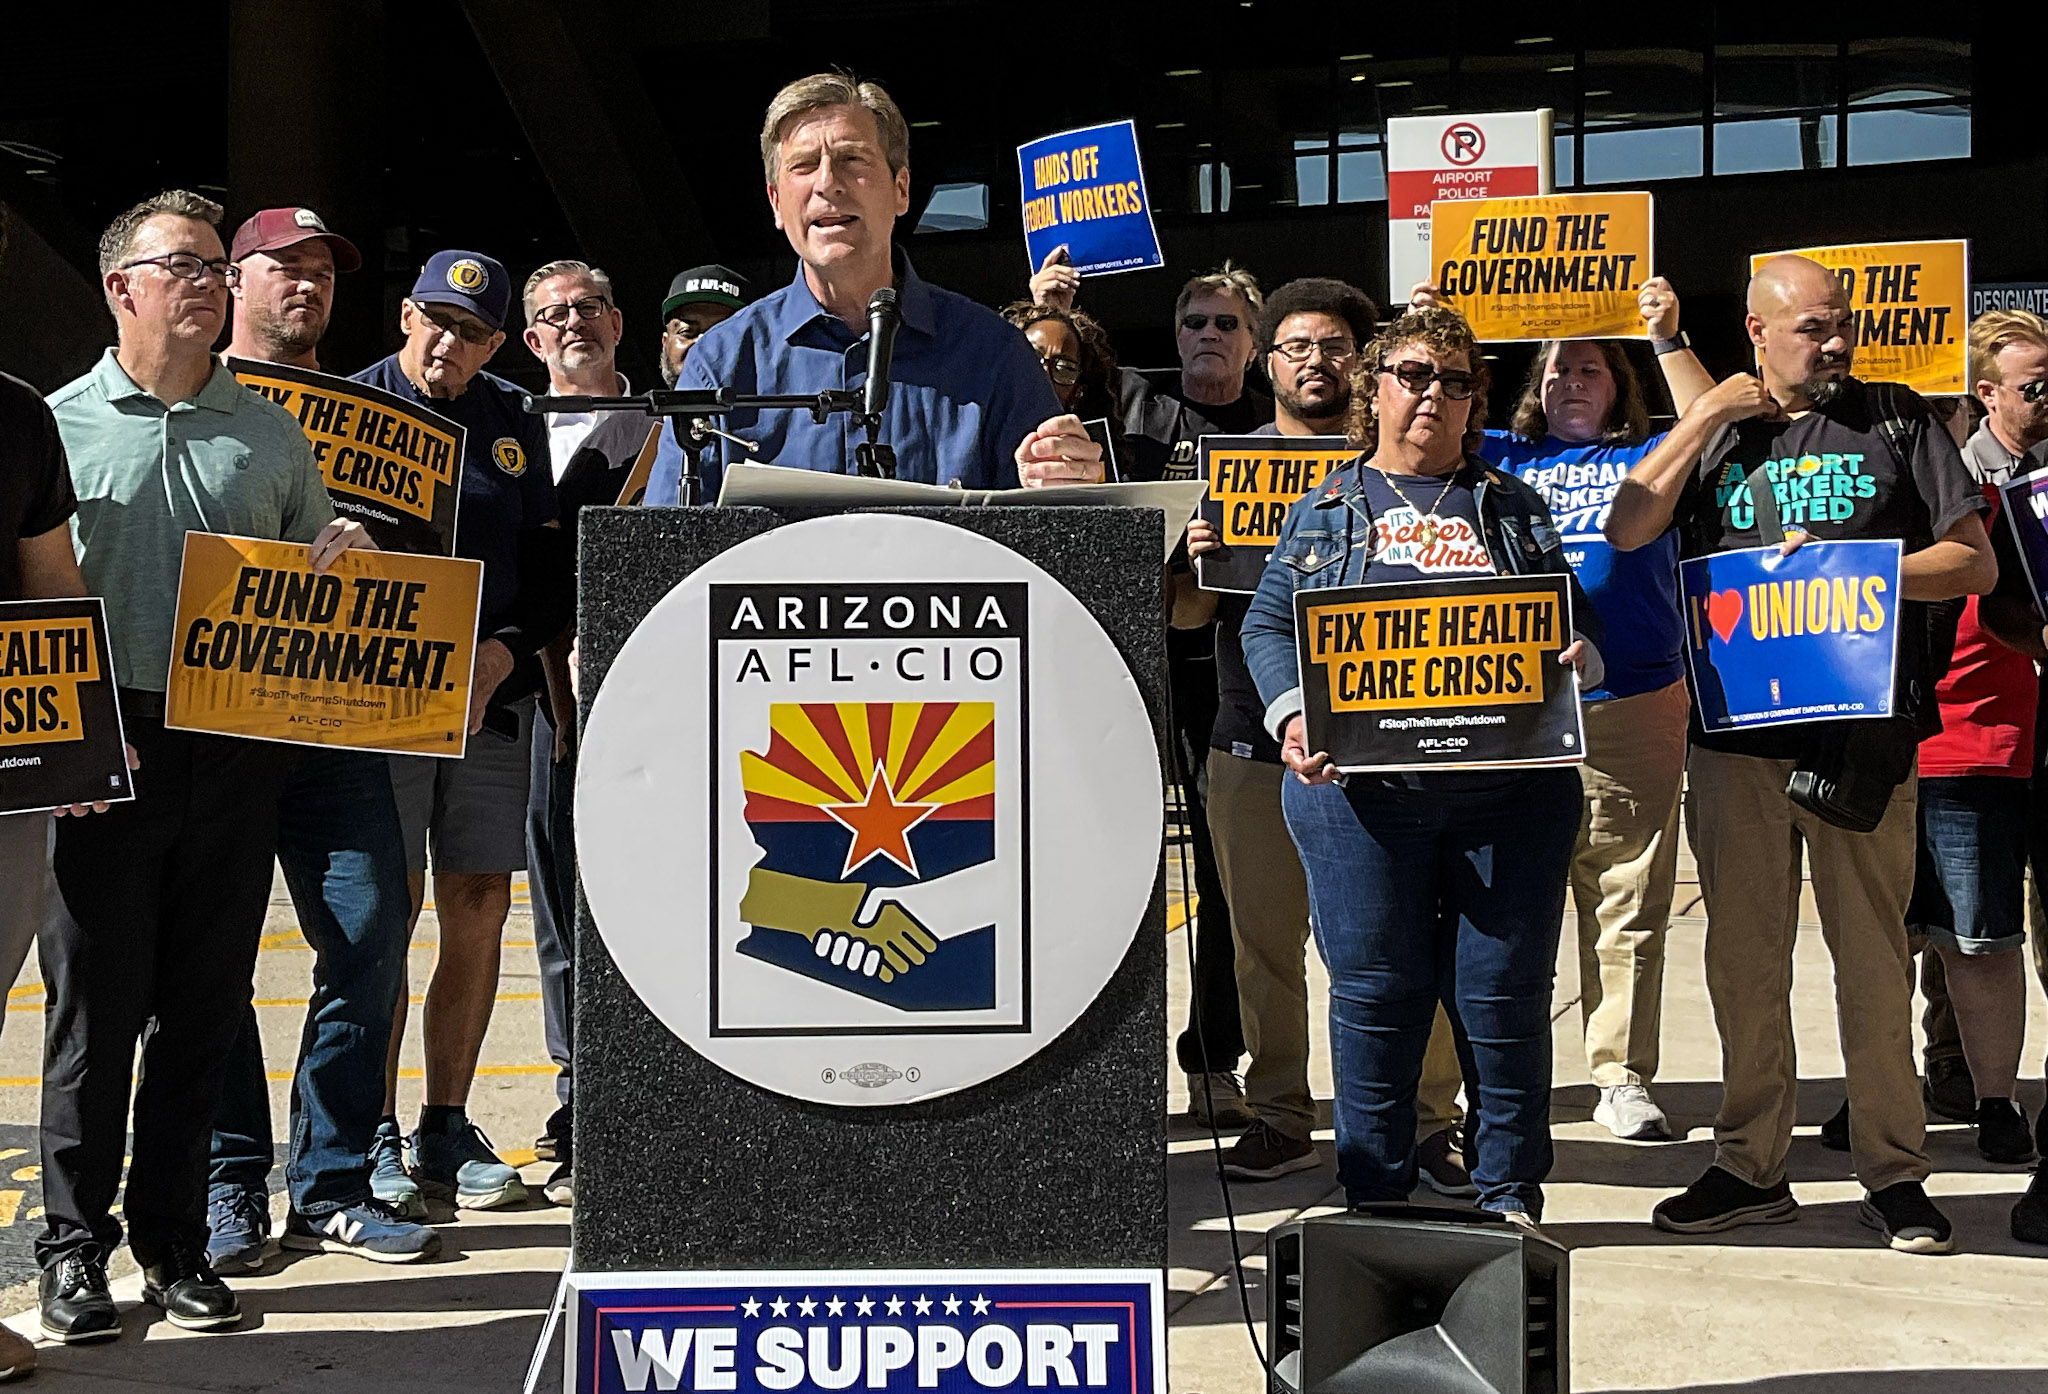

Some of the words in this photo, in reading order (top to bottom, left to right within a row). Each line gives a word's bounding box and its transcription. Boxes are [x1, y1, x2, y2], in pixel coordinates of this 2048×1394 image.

[1033, 151, 1069, 190] HANDS
[1071, 145, 1099, 182] OFF
[1432, 171, 1493, 184] AIRPORT
[1059, 181, 1142, 224] WORKERS
[1438, 187, 1488, 199] POLICE
[1413, 204, 1431, 216] PA
[1471, 216, 1548, 254] FUND
[1556, 213, 1609, 251] THE
[686, 279, 700, 292] AZ
[700, 279, 740, 297] AFL-CIO
[1439, 254, 1639, 296] GOVERNMENT.
[1865, 264, 1921, 304] THE
[1490, 303, 1591, 312] #StopTheTrumpShutdown
[1520, 319, 1561, 327] AFL-CIO
[1853, 357, 1902, 365] pShutdown
[299, 392, 354, 437] THE
[355, 407, 452, 475] HEALTH
[332, 446, 424, 508] CRISIS.
[1215, 458, 1262, 493] FIX
[1268, 459, 1318, 493] THE
[1724, 453, 1864, 485] ARPORT
[330, 497, 399, 525] TrumpShutdown
[1536, 483, 1620, 512] ORKER
[1731, 496, 1855, 530] UITED
[1231, 501, 1291, 537] CAR
[1390, 512, 1414, 527] IT'S
[1388, 546, 1401, 560] IN
[1404, 545, 1413, 559] A
[1415, 543, 1490, 568] Unio
[232, 566, 343, 624] FUND
[350, 577, 426, 632] THE
[730, 595, 1008, 631] ARIZONA
[1690, 595, 1702, 650] I
[1748, 576, 1887, 641] UNIONS
[1317, 612, 1366, 655] FIX
[1374, 608, 1431, 650] THE
[1438, 601, 1553, 647] HEALTH
[0, 628, 88, 677] ALTH
[183, 617, 456, 692] GOVERNMENT.
[1339, 659, 1417, 702] CARE
[1424, 653, 1532, 698] CRISIS.
[0, 685, 69, 735] SIS.
[249, 687, 386, 709] #StopTheTrumpShutdown
[1837, 702, 1864, 711] AFL-CIO
[288, 715, 342, 727] AFL-CIO
[1379, 714, 1506, 730] #StopTheTrumpShutdown
[1417, 737, 1469, 748] AFL-CIO
[0, 755, 41, 769] utdown
[610, 1328, 738, 1391] WE
[755, 1324, 1119, 1391] SUPPORT
